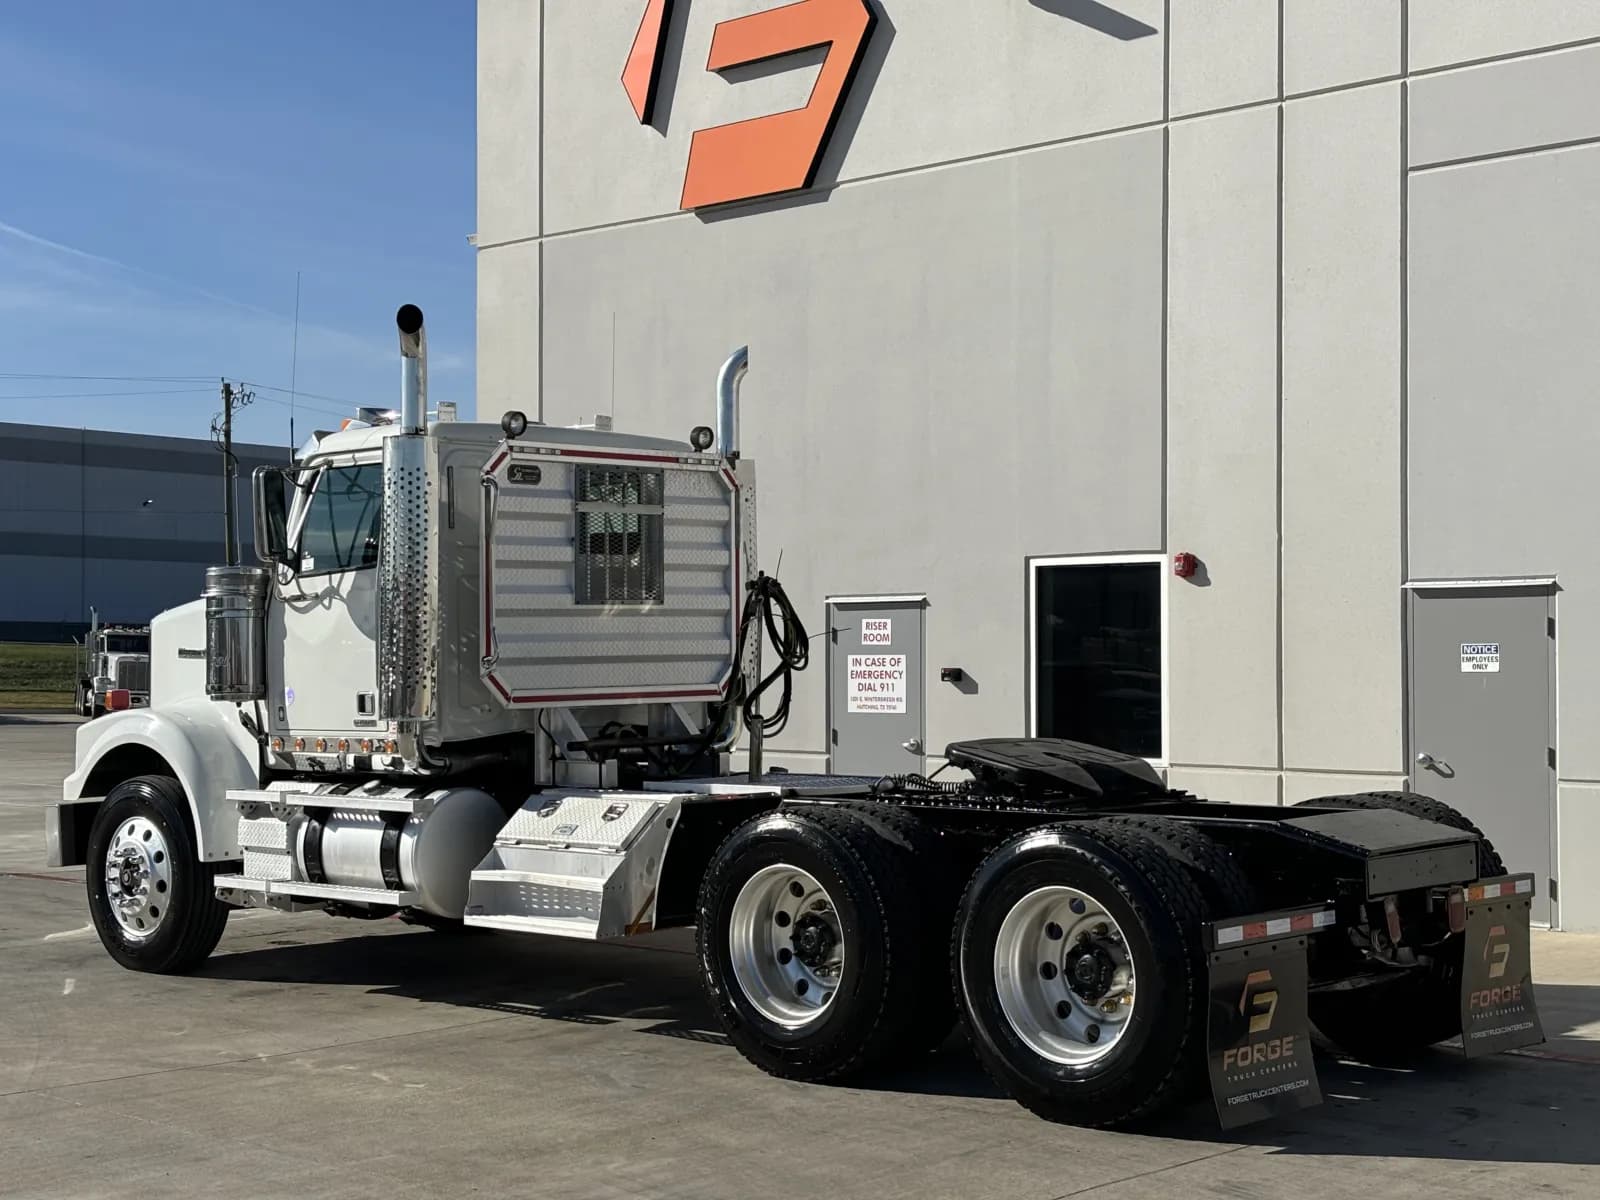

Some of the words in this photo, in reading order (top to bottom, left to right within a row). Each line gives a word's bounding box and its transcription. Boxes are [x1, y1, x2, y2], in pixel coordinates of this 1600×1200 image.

[865, 621, 888, 631] RISER
[863, 633, 890, 643] ROOM
[1463, 645, 1497, 654] NOTICE
[852, 657, 862, 667] IN
[864, 657, 887, 667] CASE
[889, 657, 902, 667] OF
[850, 670, 904, 680] EMERGENCY
[857, 682, 877, 692] DIAL
[879, 682, 895, 693] 911
[1470, 984, 1521, 1009] FORGE
[1223, 1035, 1294, 1071] FORGE
